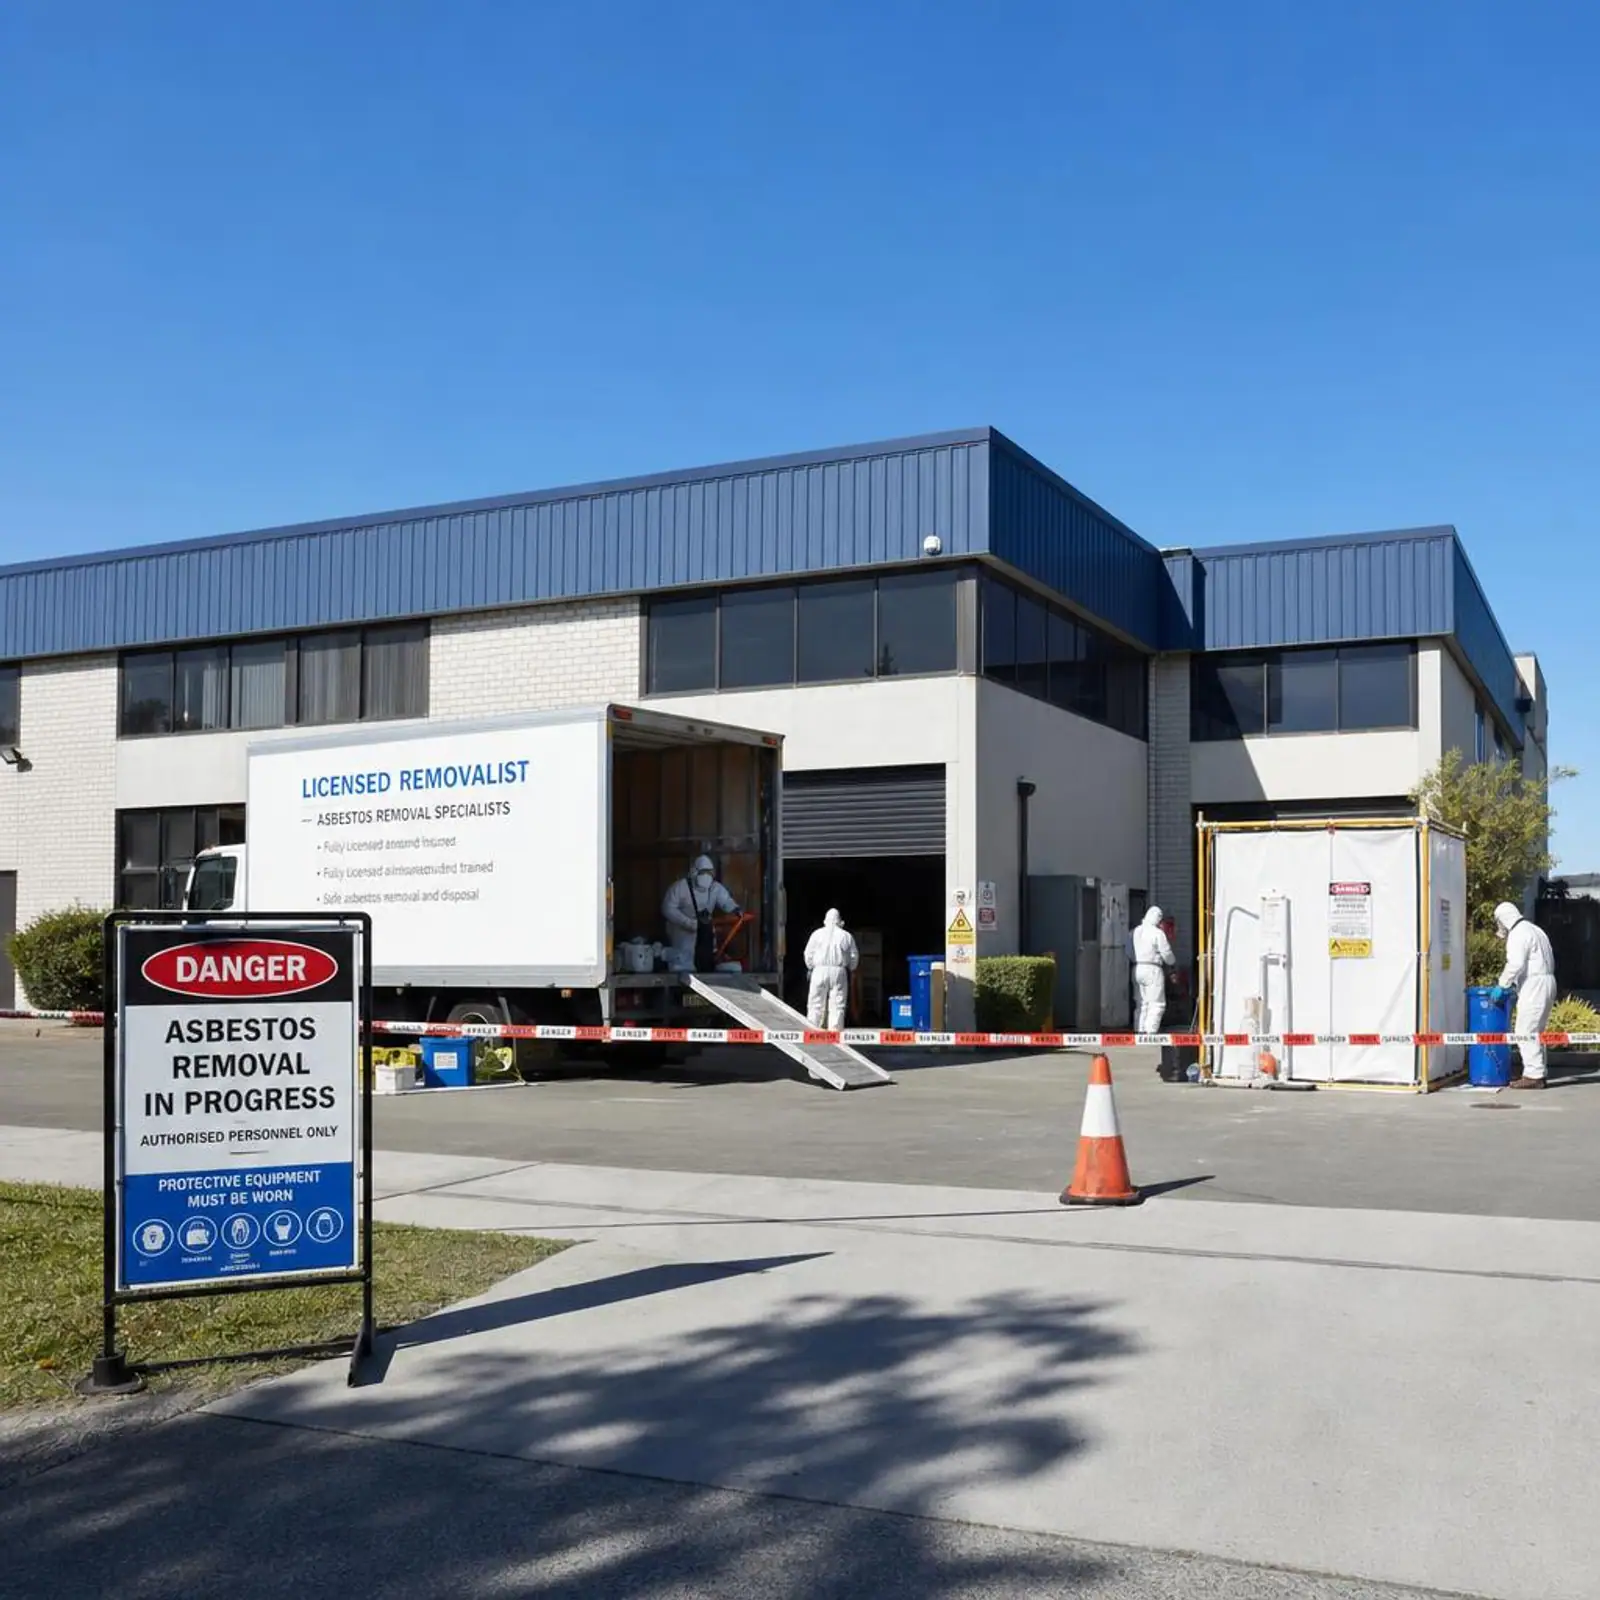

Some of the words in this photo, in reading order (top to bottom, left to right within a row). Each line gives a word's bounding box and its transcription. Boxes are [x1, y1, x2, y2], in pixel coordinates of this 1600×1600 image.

[303, 772, 391, 798] LICENSED
[400, 760, 529, 791] REMOVALIST
[317, 810, 372, 826] ASBESTOS
[376, 806, 431, 822] REMOVAL
[434, 801, 511, 819] SPECIALISTS
[421, 890, 439, 902] and
[440, 888, 480, 905] disposal
[175, 955, 307, 983] DANGER
[165, 1017, 316, 1044] ASBESTOS
[173, 1052, 310, 1079] REMOVAL
[144, 1092, 173, 1116] IN
[185, 1086, 335, 1115] PROGRESS
[140, 1130, 225, 1147] AUTHORISED
[228, 1127, 303, 1142] PERSONNEL
[307, 1125, 338, 1138] ONLY
[158, 1174, 241, 1192] PROTECTIVE
[245, 1170, 322, 1188] EQUIPMENT
[187, 1193, 226, 1208] MUST
[230, 1191, 248, 1205] BE
[252, 1189, 293, 1204] WORN
